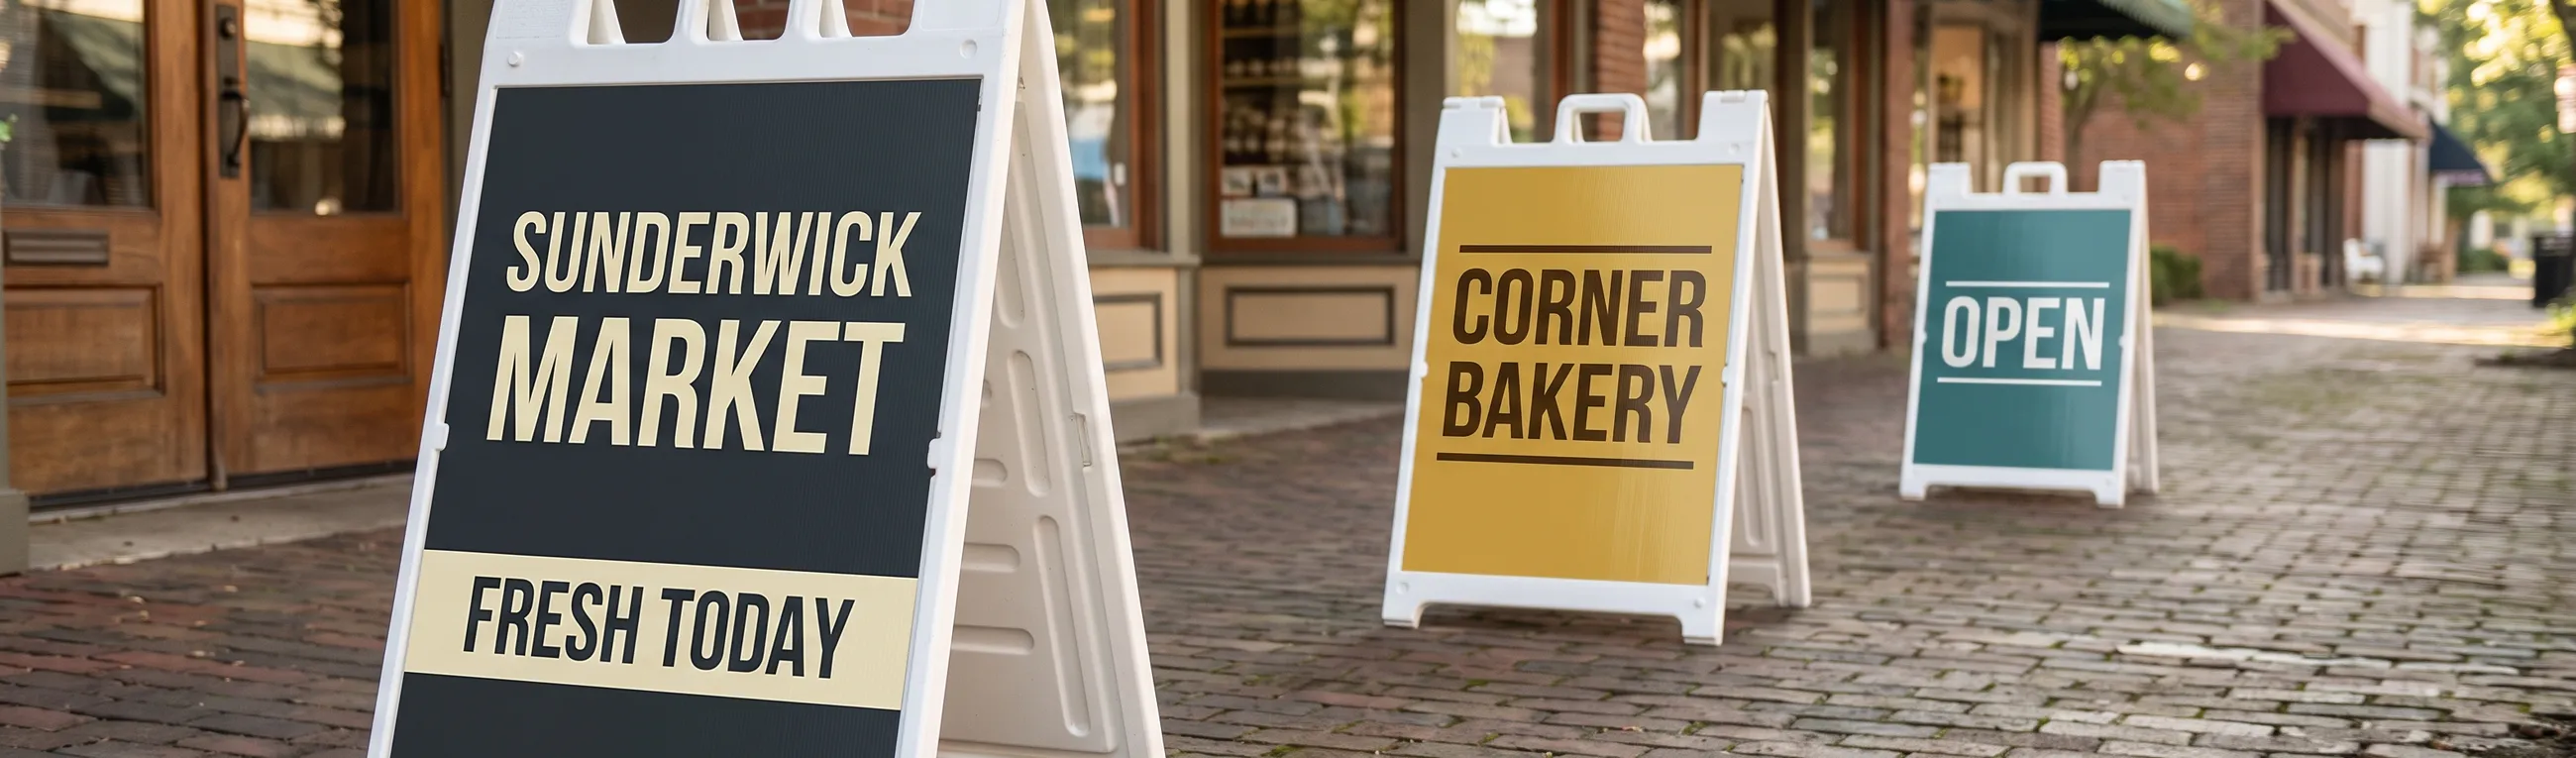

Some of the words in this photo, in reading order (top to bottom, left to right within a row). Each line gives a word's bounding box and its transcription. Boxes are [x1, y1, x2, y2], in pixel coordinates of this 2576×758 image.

[507, 211, 921, 296] SUNDERWICK
[1452, 268, 1706, 347] CORNER
[1941, 295, 2105, 370] OPEN
[486, 316, 905, 455] MARKET
[1443, 361, 1701, 444] BAKERY
[463, 576, 643, 664] FRESH
[661, 588, 855, 679] TODAY
